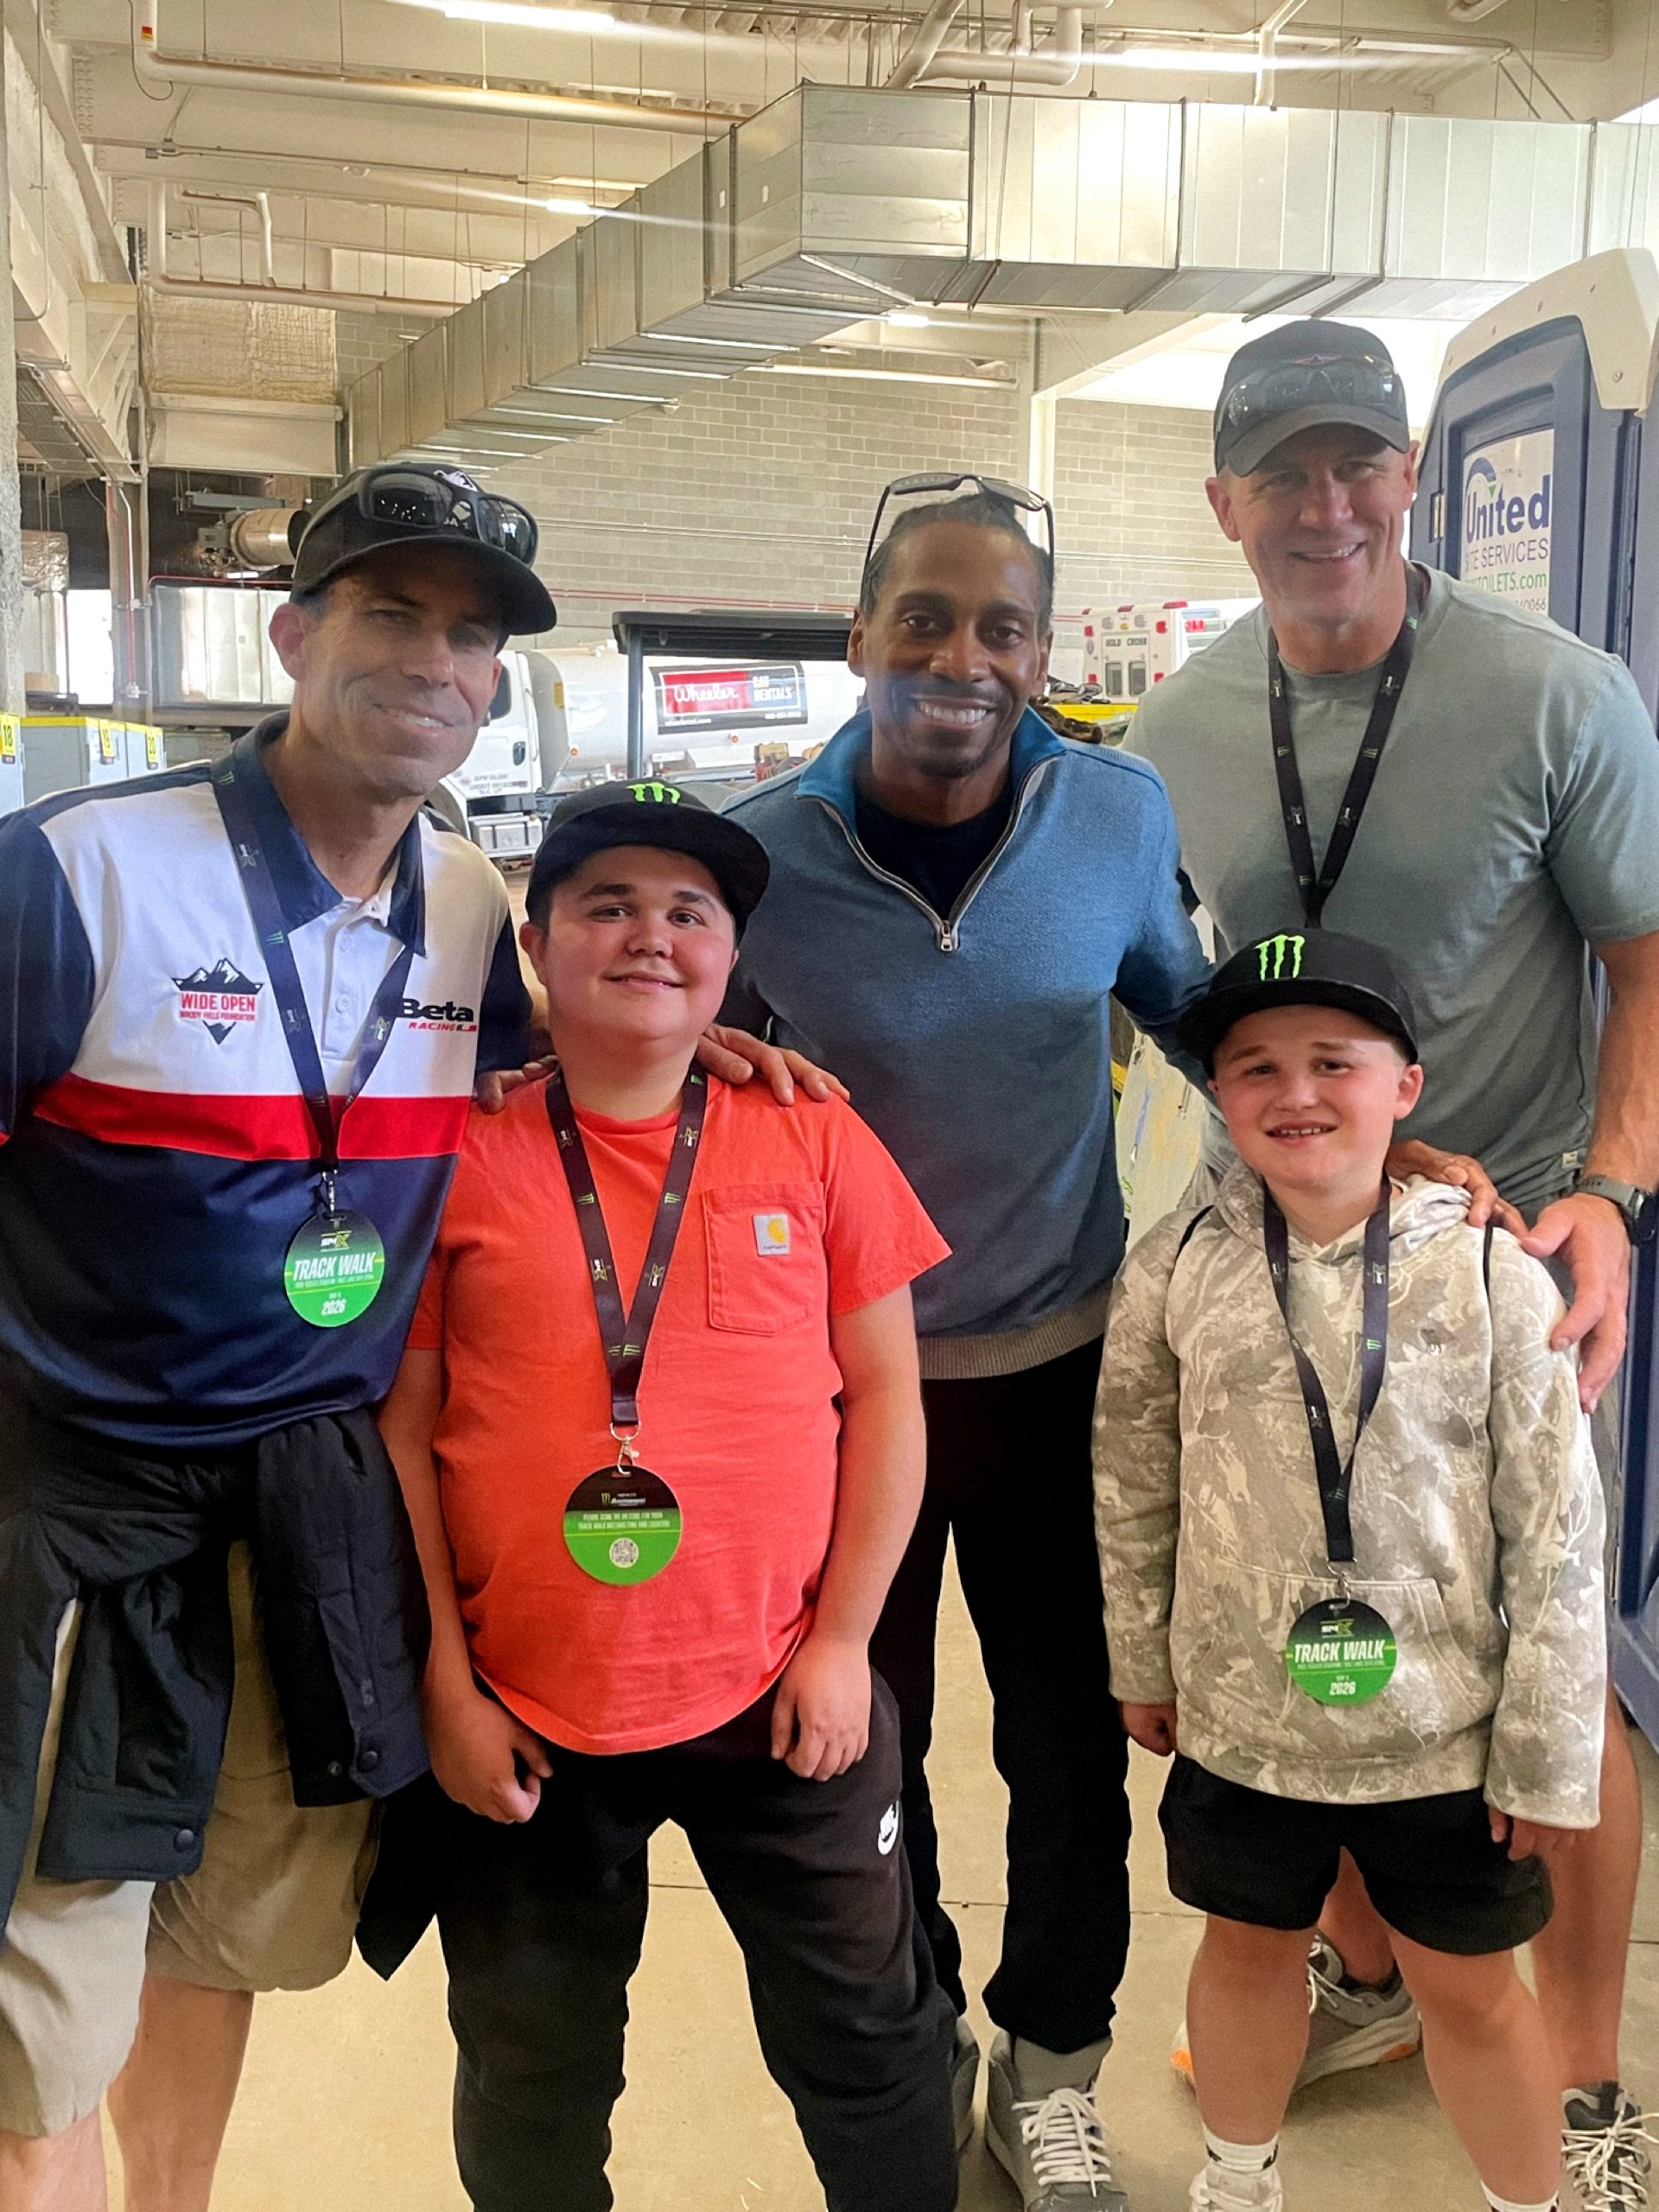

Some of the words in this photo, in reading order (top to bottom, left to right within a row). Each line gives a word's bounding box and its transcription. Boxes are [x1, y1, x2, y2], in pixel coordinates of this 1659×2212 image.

[1465, 474, 1551, 543] United
[1481, 538, 1549, 568] SERVICES
[673, 683, 740, 702] Wheeler
[753, 687, 793, 702] RENTALS
[3, 725, 14, 747] 18
[181, 993, 217, 1010] WIDE
[221, 995, 256, 1011] OPEN
[402, 998, 474, 1022] Beta
[409, 1022, 454, 1032] RACING
[293, 1256, 337, 1281] TRACK
[338, 1252, 377, 1276] WALK
[1294, 1642, 1341, 1663] TRACK
[1344, 1639, 1386, 1660] WALK
